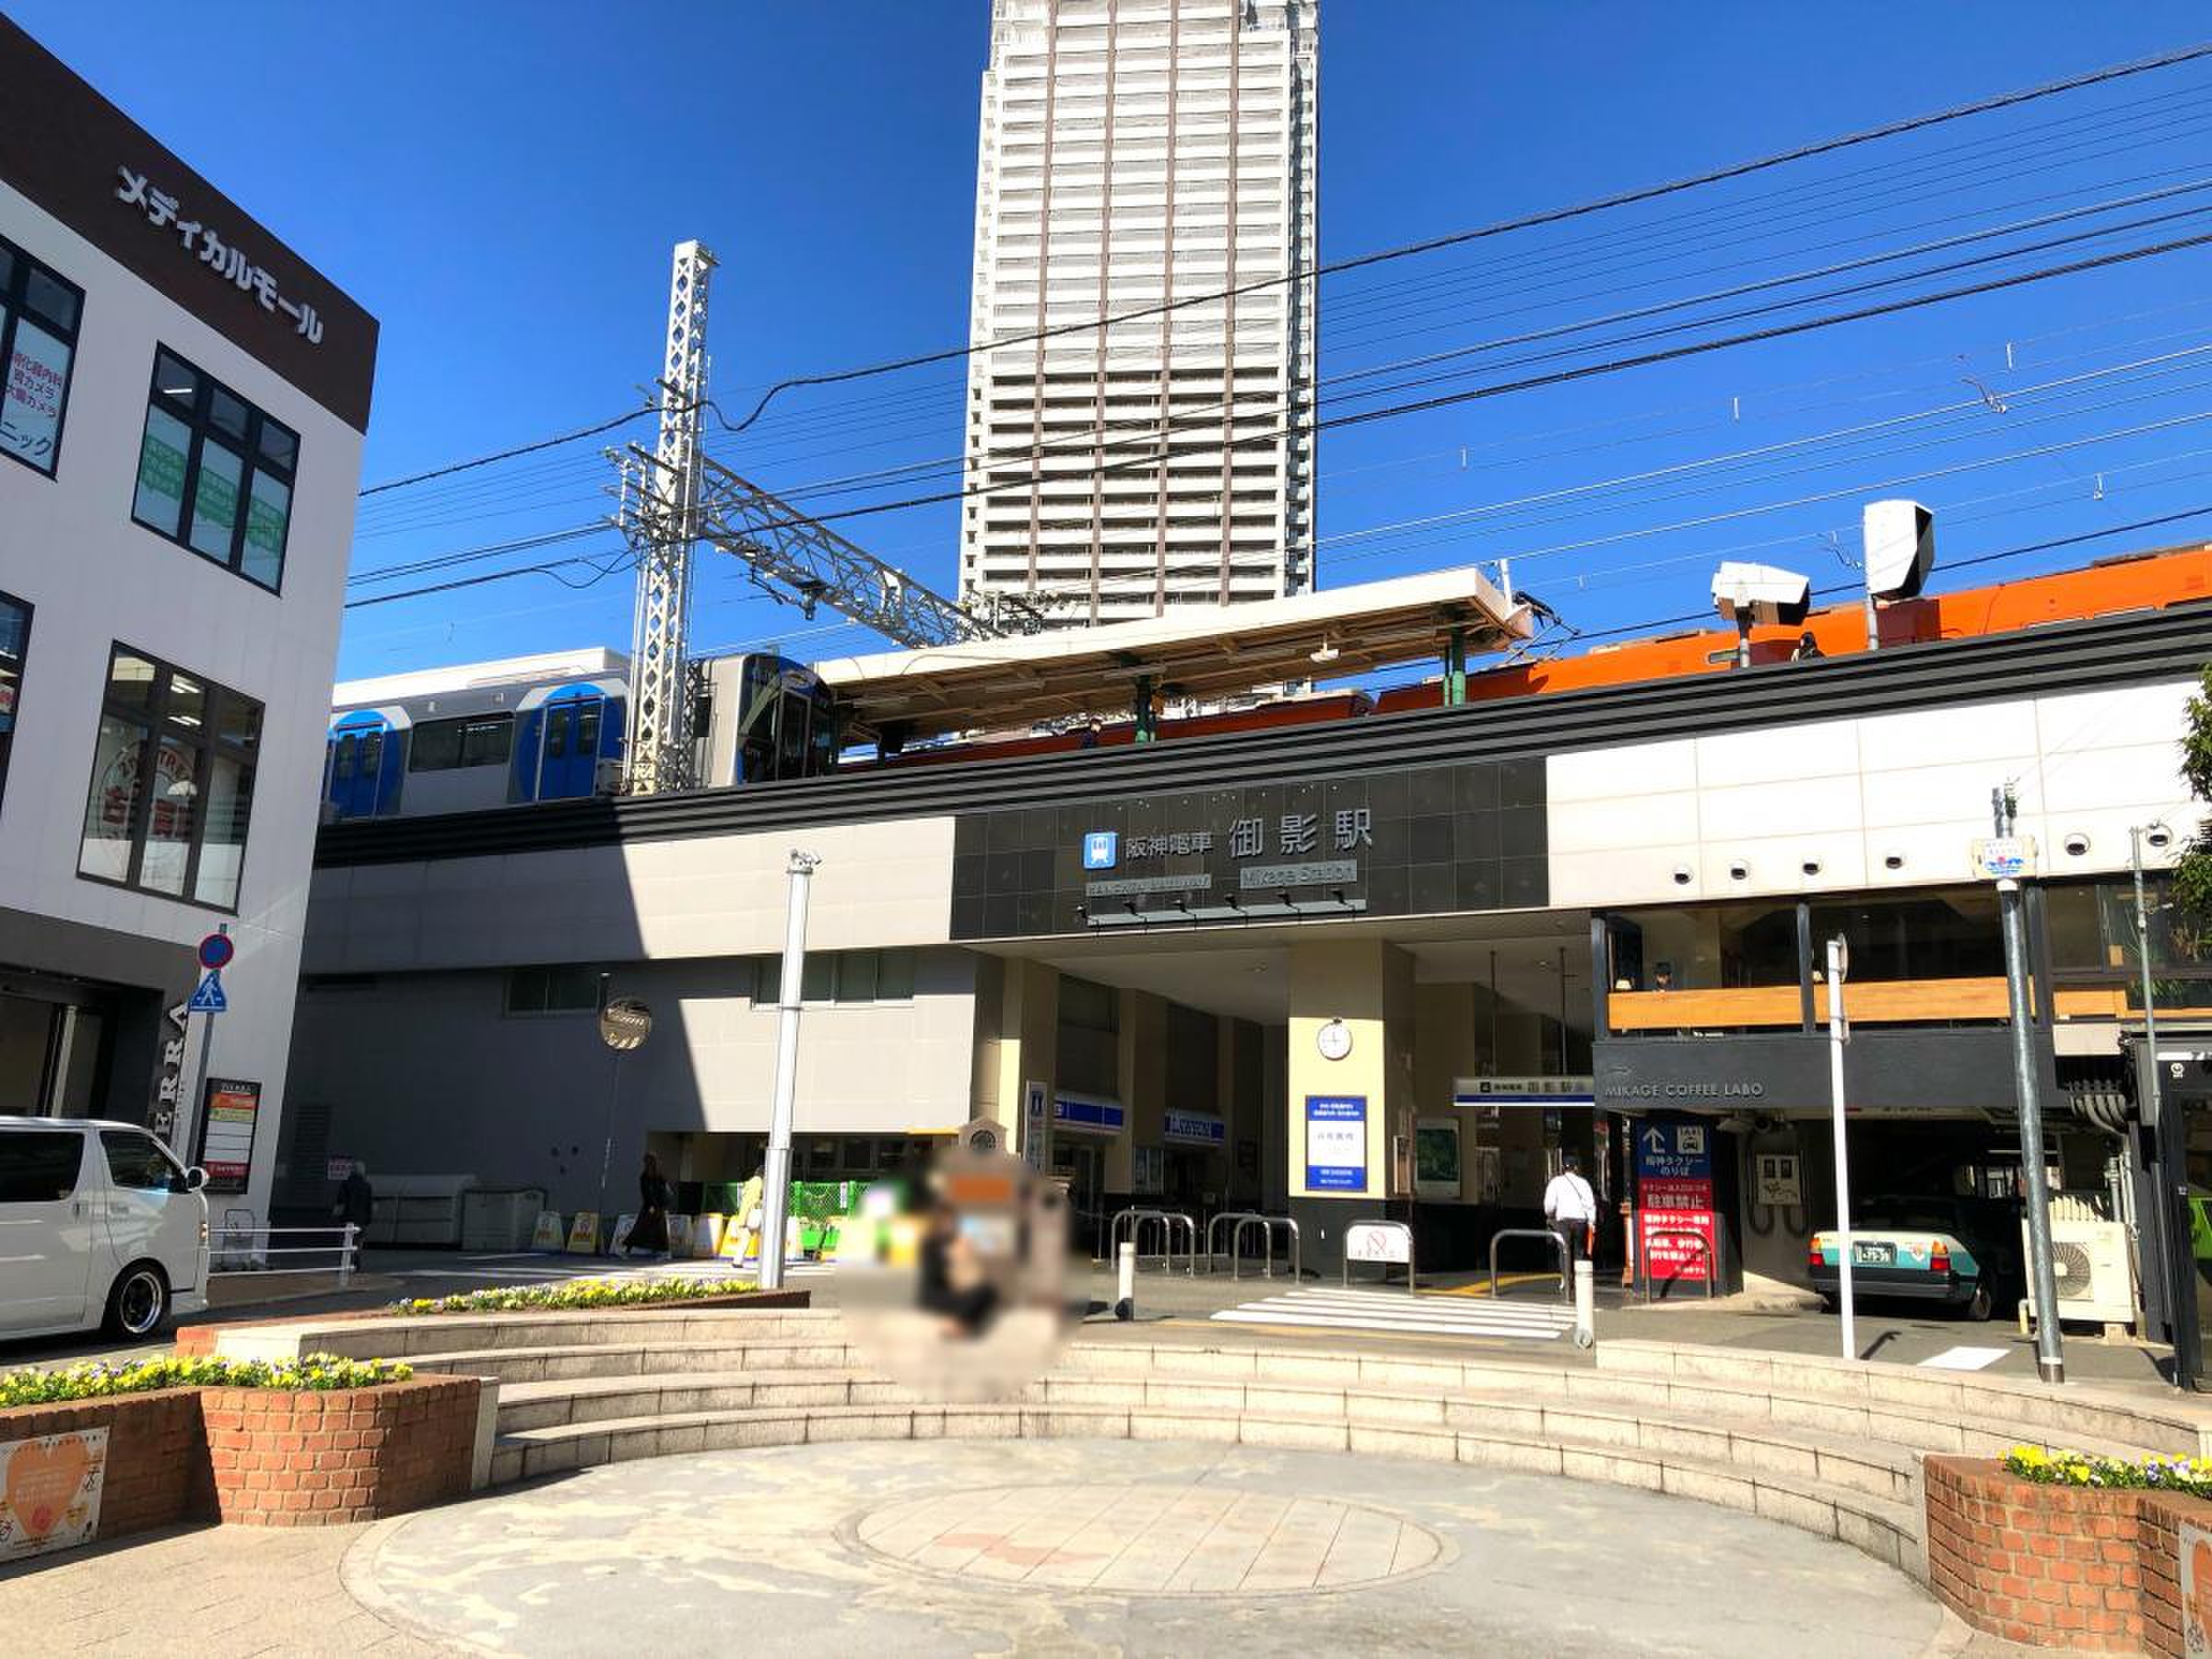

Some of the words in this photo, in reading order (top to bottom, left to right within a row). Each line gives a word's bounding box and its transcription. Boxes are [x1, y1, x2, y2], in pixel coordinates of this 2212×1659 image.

[116, 165, 324, 345] メディカルモール
[1125, 832, 1214, 859] 阪神電車
[1230, 808, 1372, 858] 御影駅
[1606, 1084, 1659, 1098] MIKAGE
[1665, 1084, 1719, 1097] COFFEE
[1724, 1082, 1764, 1097] LABO
[1660, 1166, 1690, 1177] のりば
